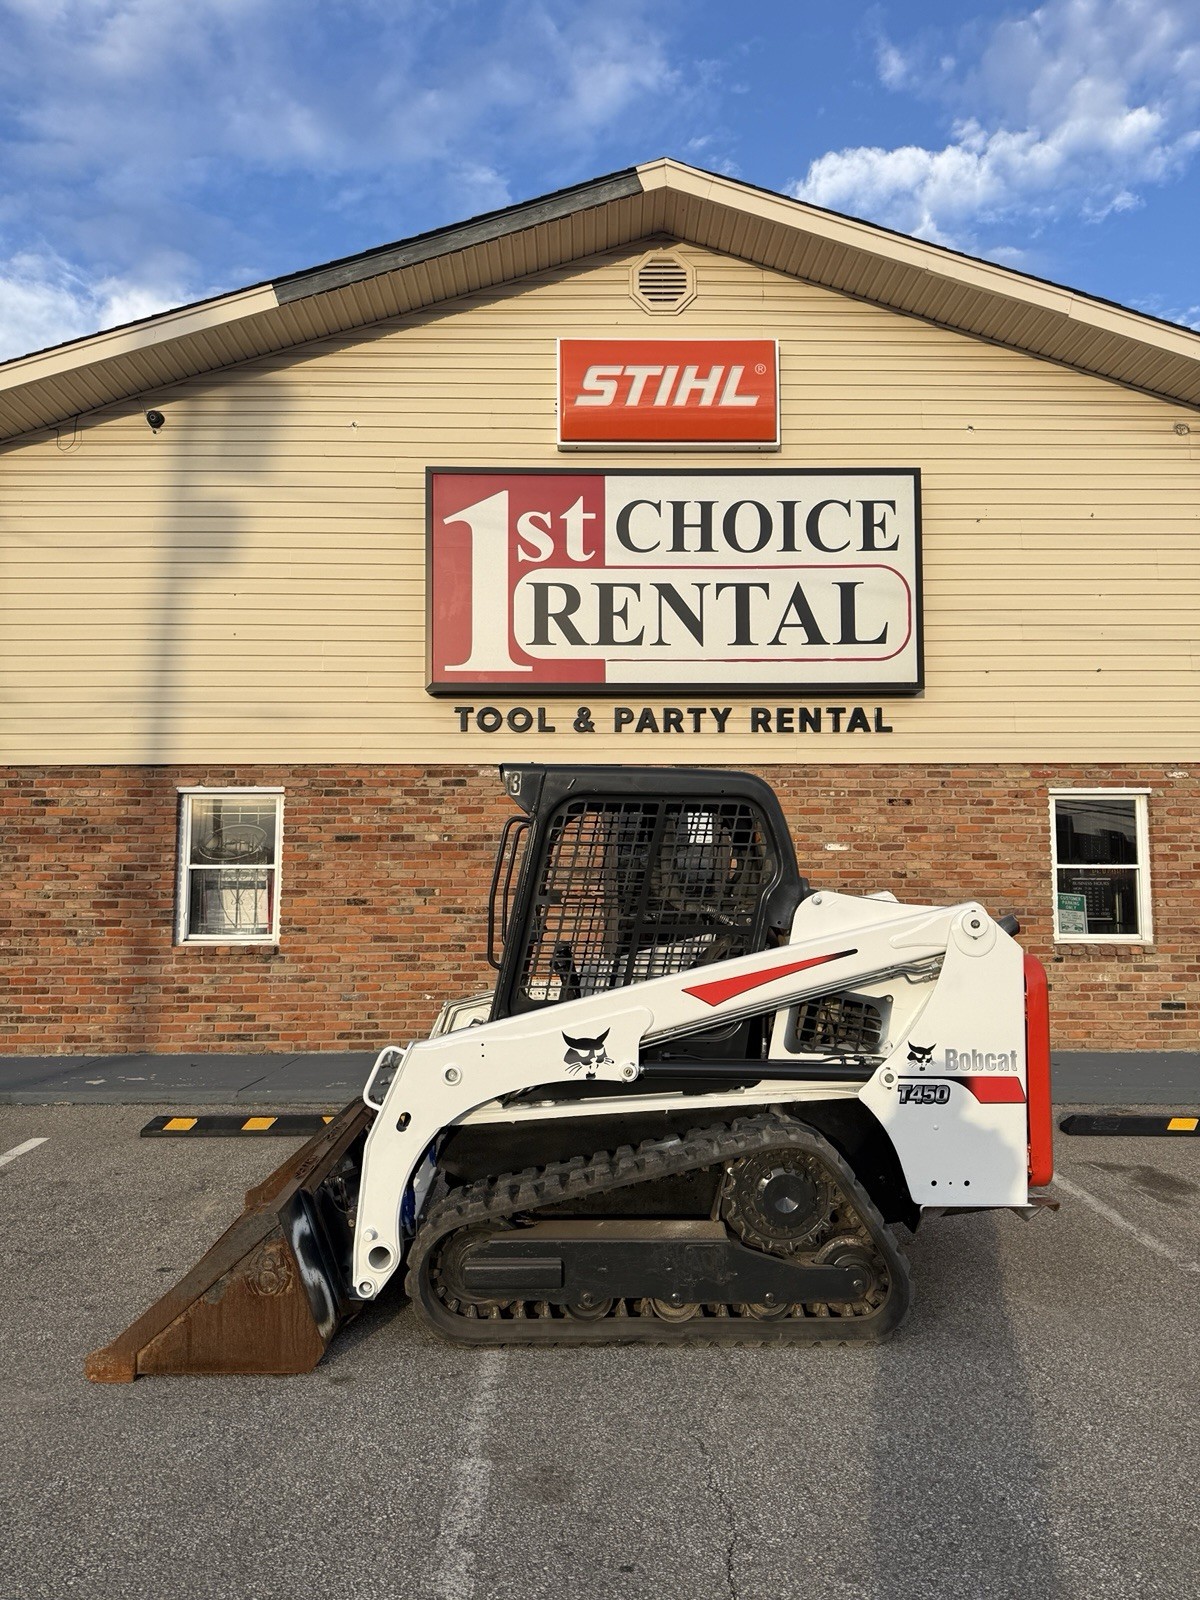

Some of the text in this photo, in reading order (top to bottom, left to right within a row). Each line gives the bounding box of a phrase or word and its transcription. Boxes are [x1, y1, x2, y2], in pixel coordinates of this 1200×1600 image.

[574, 365, 760, 407] STIHL
[443, 490, 900, 672] 1st CHOICE
[525, 581, 889, 648] RENTAL
[454, 706, 893, 734] TOOL & PARTY RENTAL
[944, 1048, 1018, 1072] Bobcat
[898, 1084, 951, 1105] T450
